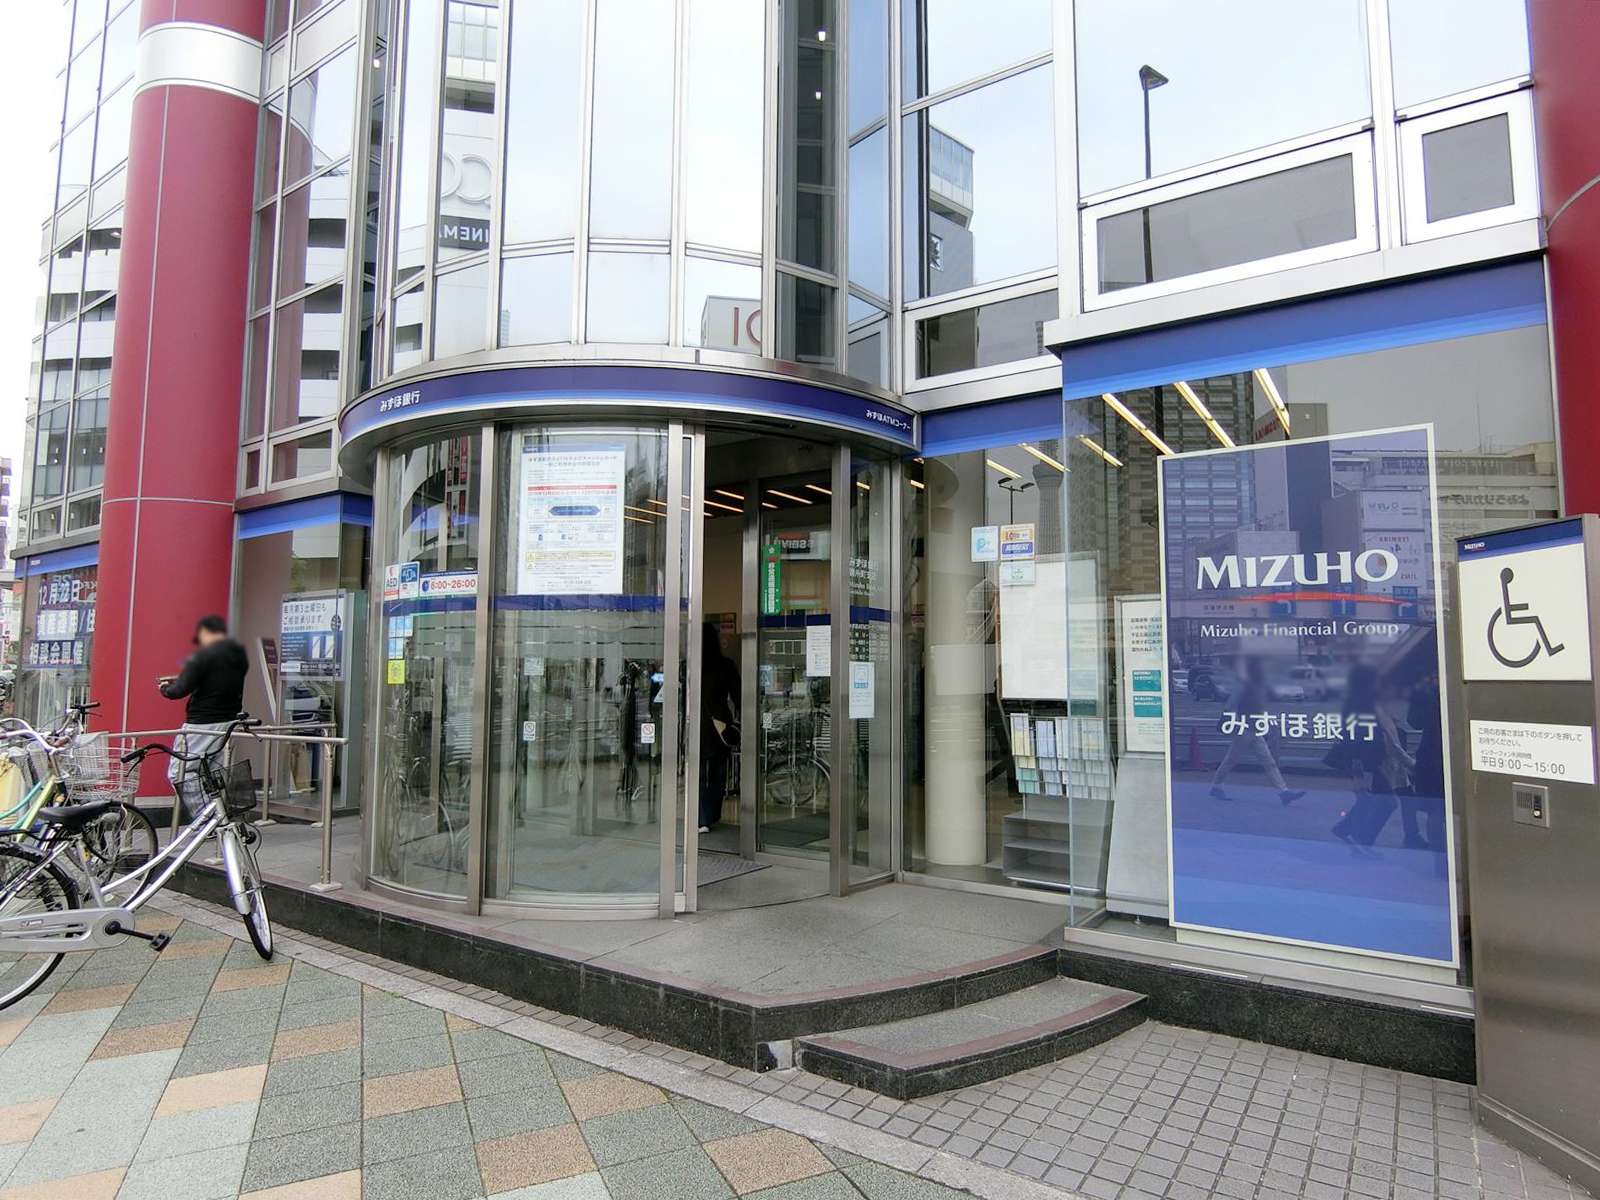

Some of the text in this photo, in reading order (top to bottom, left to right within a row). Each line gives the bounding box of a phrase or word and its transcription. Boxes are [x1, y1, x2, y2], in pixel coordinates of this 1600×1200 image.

[380, 390, 421, 412] みずほ銀行
[866, 409, 911, 430] みずほATMコーナー
[1196, 548, 1399, 590] MIZUHO
[386, 577, 398, 588] AED
[1200, 621, 1399, 638] Mizuho Financial Group
[30, 641, 83, 665] 相談会開催
[1221, 711, 1378, 741] みずほ銀行
[1478, 727, 1583, 742] ご用のお客さまは下のボタンを押して
[1479, 737, 1522, 747] お待ちください。
